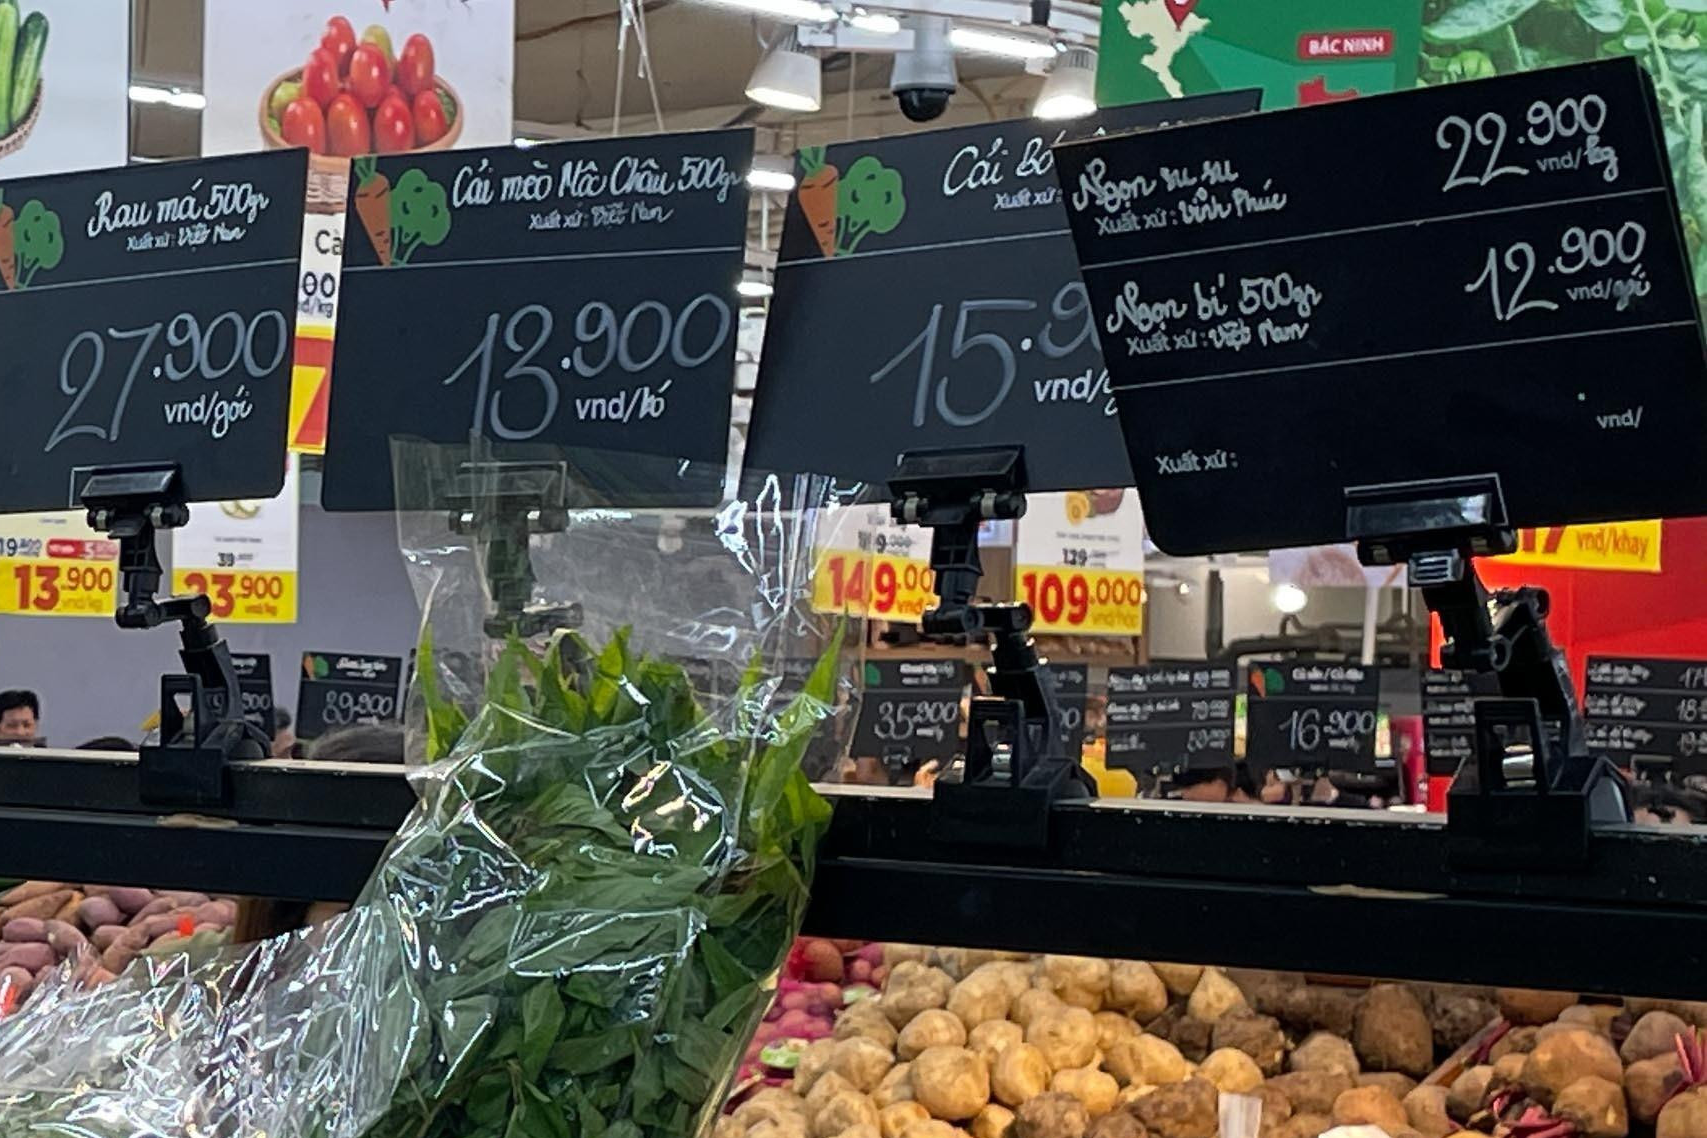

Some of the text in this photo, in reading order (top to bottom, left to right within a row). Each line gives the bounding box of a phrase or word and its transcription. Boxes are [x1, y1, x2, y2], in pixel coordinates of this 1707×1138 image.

[1343, 36, 1385, 54] NINH
[943, 137, 1010, 196] Cải
[1436, 94, 1607, 193] 22.900
[87, 190, 153, 238] Rau
[156, 178, 204, 224] má
[1072, 157, 1157, 213] Ngọn
[1095, 209, 1141, 236] Xuất
[1464, 221, 1647, 321] 12.900
[1106, 281, 1188, 334] Ngọn
[442, 293, 733, 441] 13.900
[1125, 328, 1172, 356] Xuất
[44, 309, 288, 452] 27.900
[1596, 406, 1643, 430] vnd/
[1155, 453, 1200, 475] Xuất
[14, 564, 114, 611] 13.900
[1021, 572, 1143, 626] 109.000
